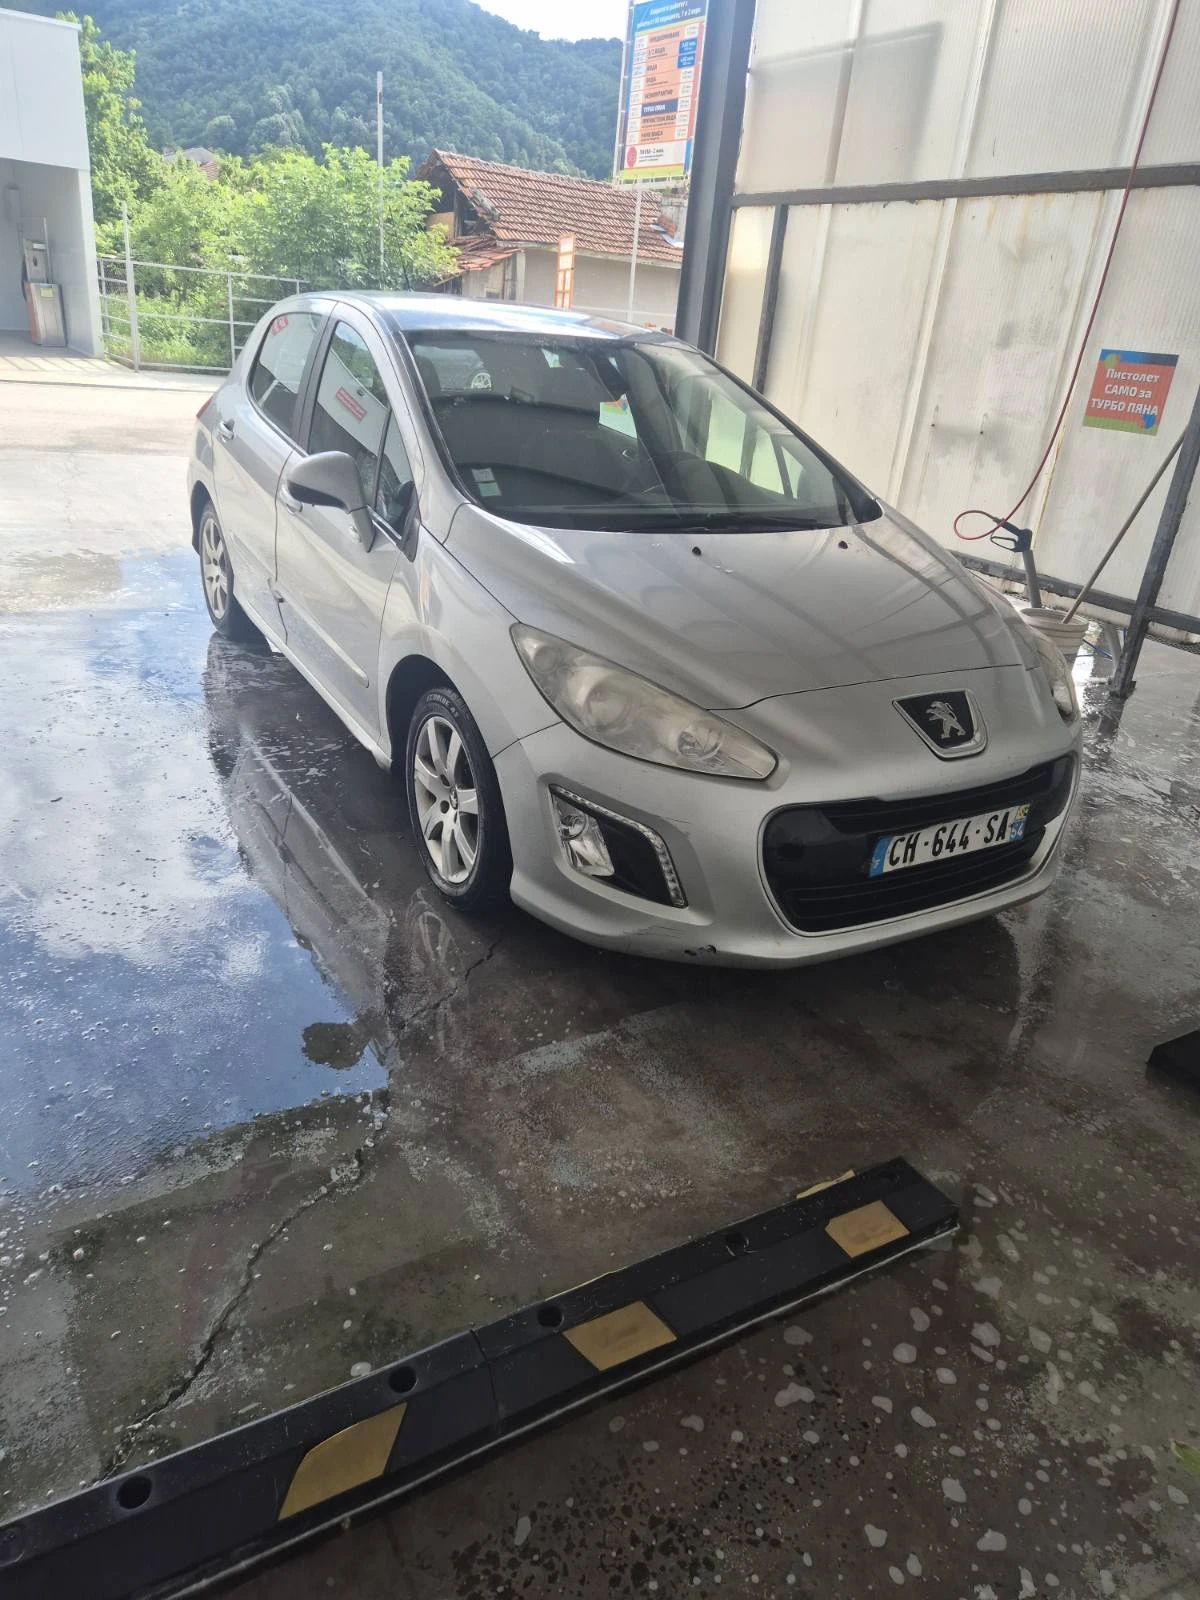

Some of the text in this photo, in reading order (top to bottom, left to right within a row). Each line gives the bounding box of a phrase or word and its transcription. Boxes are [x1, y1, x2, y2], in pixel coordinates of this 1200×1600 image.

[1106, 368, 1160, 383] Пистолет
[1104, 384, 1152, 399] САМО за
[1091, 398, 1159, 416] ТУРБО ПЯНА
